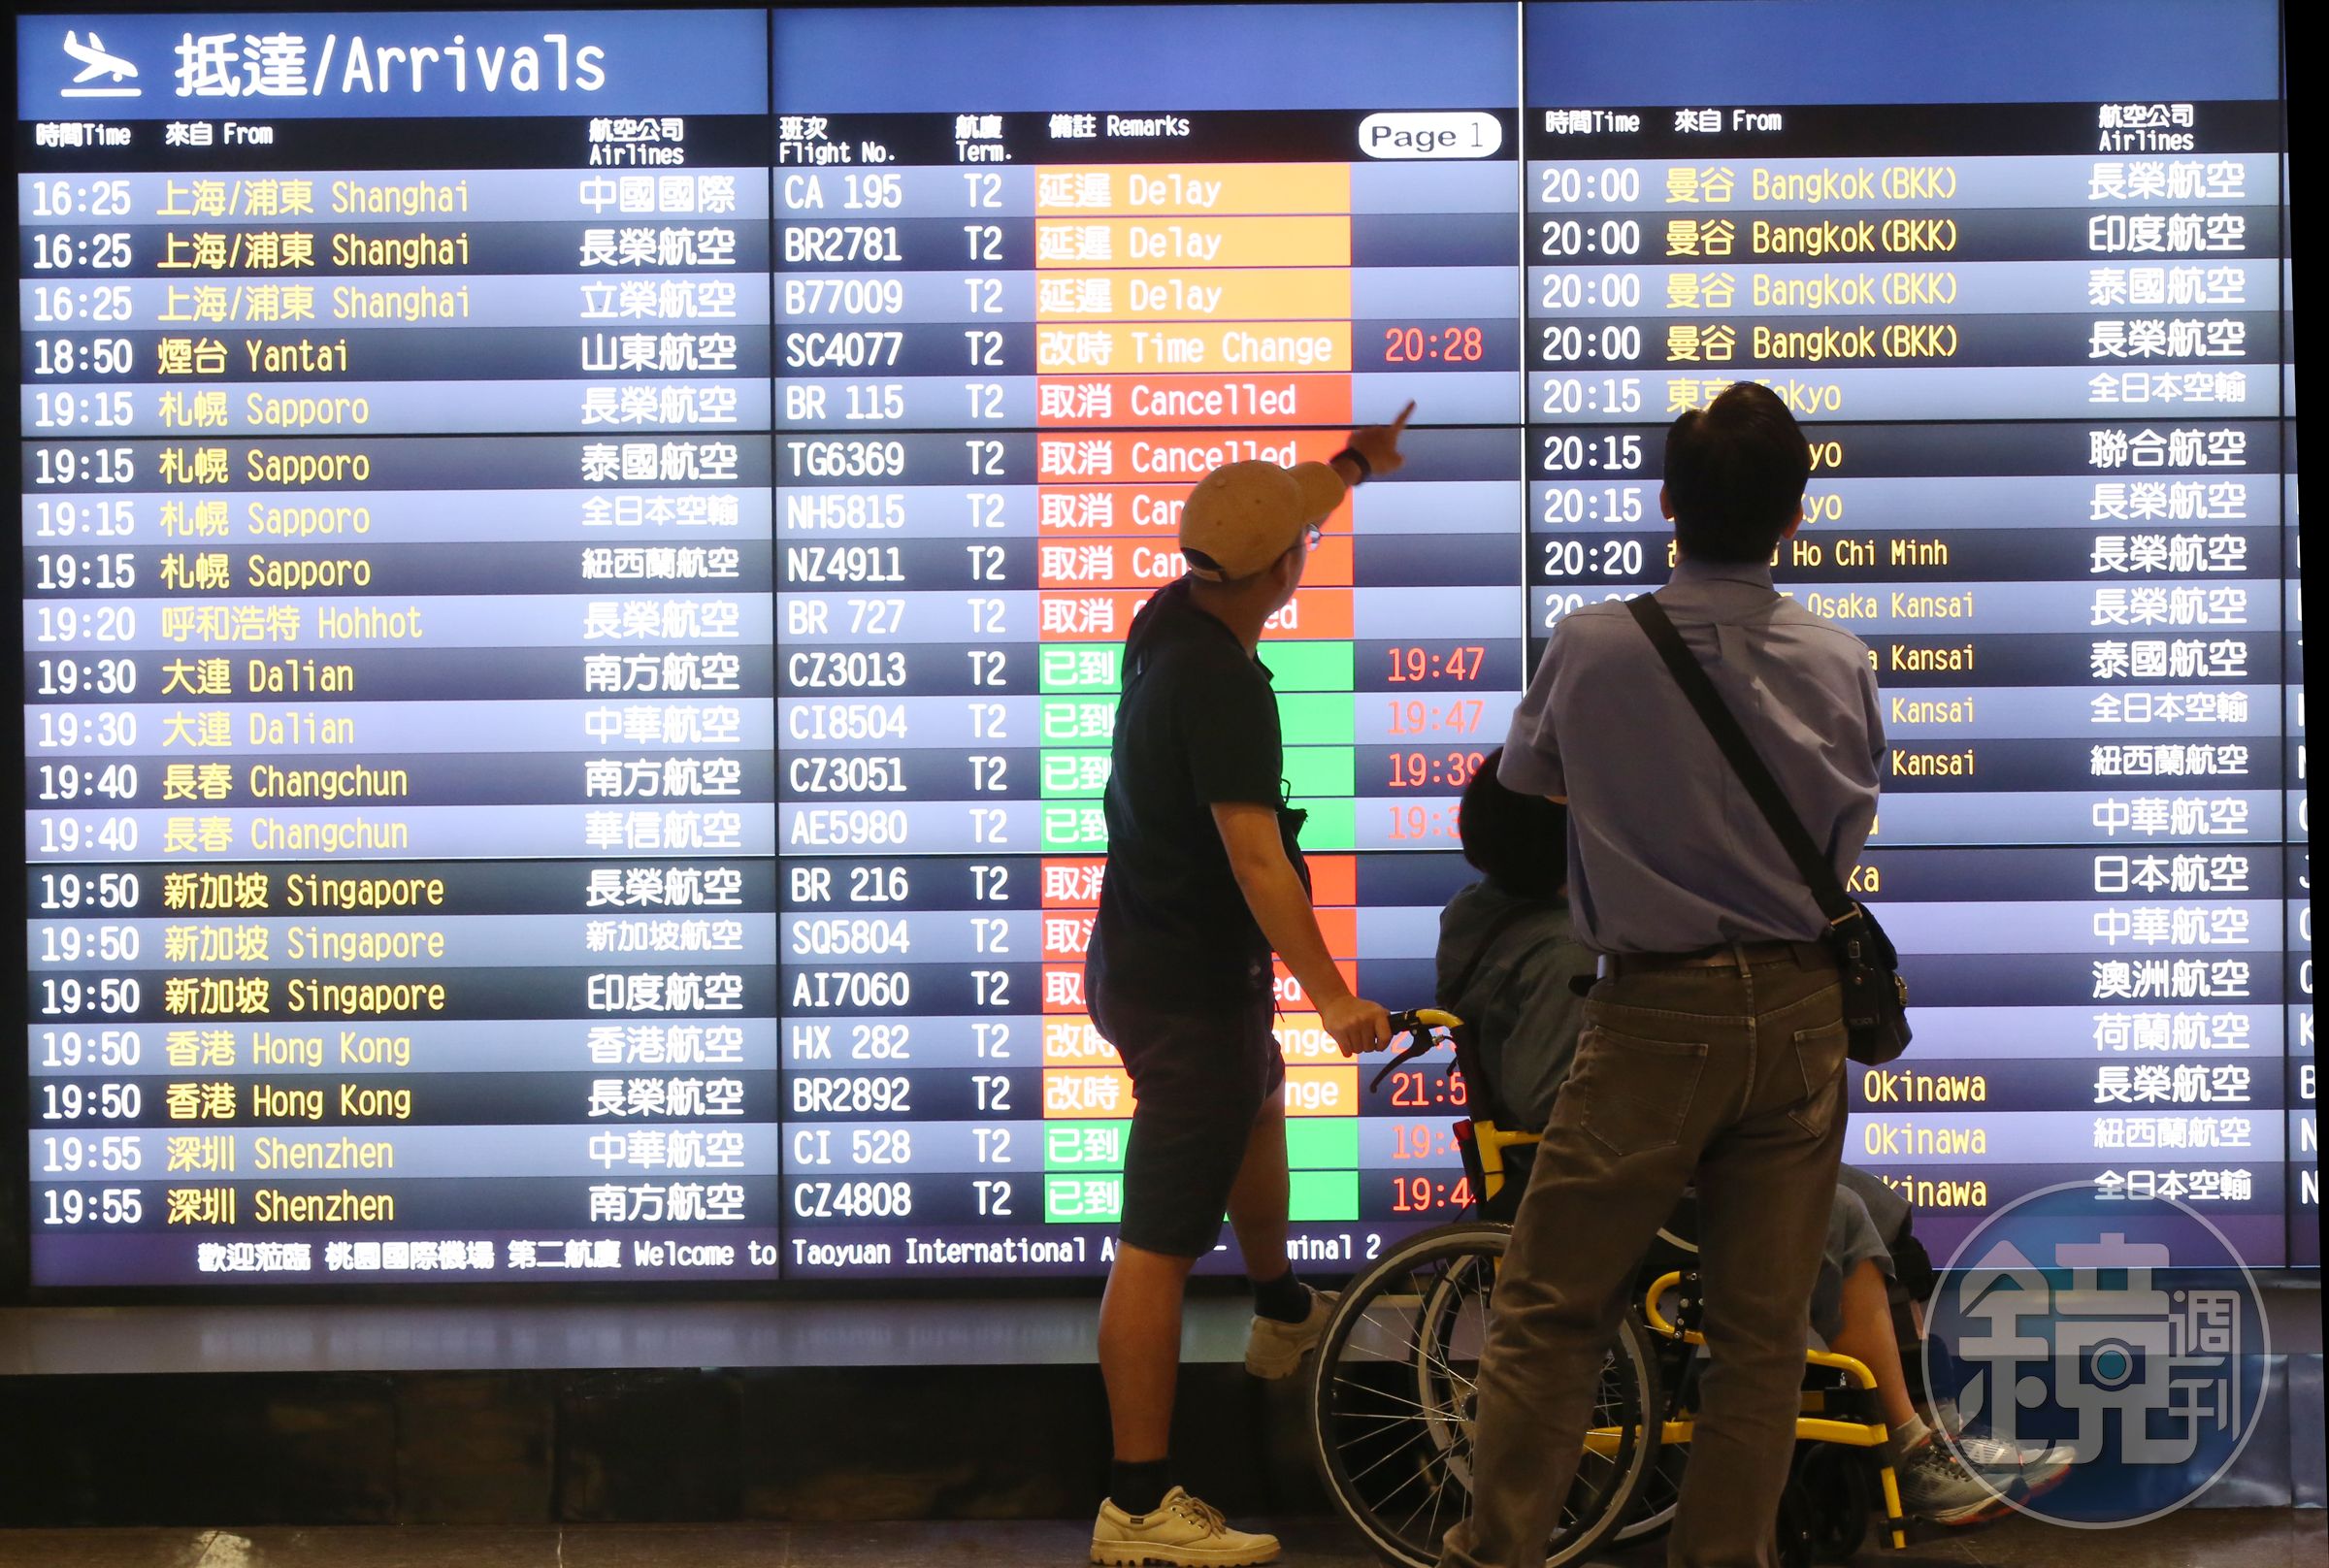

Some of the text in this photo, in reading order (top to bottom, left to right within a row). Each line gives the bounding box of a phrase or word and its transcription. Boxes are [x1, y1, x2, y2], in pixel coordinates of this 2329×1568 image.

[174, 31, 606, 98] 抵達/Arrivals
[35, 121, 132, 148] 時間Time
[165, 120, 274, 147] 來自 From
[588, 117, 684, 143] 航空公司
[1106, 114, 1191, 137] Remarks
[1545, 109, 1641, 135] 時間Time
[1674, 108, 1783, 134] 來自 From
[2098, 103, 2194, 129] 航空公司
[589, 143, 685, 166] Airlines
[779, 141, 896, 166] Flight No.
[955, 140, 1012, 163] Term.
[1371, 121, 1484, 152] Page 1
[2098, 129, 2195, 152] Airlines
[32, 180, 131, 216] 16:25
[156, 178, 469, 217] 上海/浦東 Shanghai
[579, 175, 736, 214] 中國國際
[784, 173, 902, 210] CA 195
[963, 172, 1002, 208] T2
[1038, 172, 1223, 209] 延遲 Delay
[1541, 167, 1640, 203] 20:00
[1664, 166, 1957, 204] 曼谷 Bangkok(BKK)
[2087, 159, 2246, 201] 長榮航空
[33, 232, 132, 269] 16:25
[155, 230, 470, 271] 上海/浦東 Shanghai
[578, 226, 737, 267] 長榮航空
[784, 226, 902, 262] BR2781
[964, 225, 1003, 261] T2
[1038, 225, 1223, 261] 延遲 Delay
[1542, 219, 1640, 256] 20:00
[1664, 218, 1958, 258] 曼谷 Bangkok(BKK)
[2088, 212, 2246, 253] 印度航空
[2087, 265, 2246, 307] 泰國航空
[34, 338, 133, 375] 18:50
[156, 337, 349, 376] 煙台 Yantai
[581, 332, 738, 373] 山東航空
[786, 331, 903, 368] SC4077
[964, 330, 1004, 366] T2
[1039, 330, 1333, 367] 改時 Time Change
[1384, 326, 1484, 363] 20:28
[580, 384, 738, 425] 長榮航空
[786, 383, 904, 420] BR 115
[965, 382, 1004, 418] T2
[1039, 382, 1296, 419] 取消 Cancelled
[1543, 377, 1641, 413] 20:15
[2087, 370, 2247, 404] 全日本空輸
[35, 390, 134, 427] 19:15
[158, 390, 371, 429] 札幌 Sapporo
[1543, 435, 1642, 471] 20:15
[2088, 428, 2247, 469] 聯合航空
[37, 553, 136, 589] 19:15
[159, 552, 373, 591] 札幌 Sapporo
[581, 545, 739, 580] 紐西蘭航空
[787, 546, 905, 582] NZ4911
[966, 545, 1006, 581] T2
[1040, 544, 1114, 581] 取消
[1544, 539, 1643, 575] 20:20
[1791, 539, 1951, 568] Ho Chi Minh
[2089, 533, 2247, 573] 長榮航空
[37, 605, 136, 642] 19:20
[161, 604, 424, 643] 呼和浩特 Hohhot
[582, 599, 739, 639] 長榮航空
[788, 599, 906, 635] BR 727
[967, 598, 1006, 634] T2
[1041, 597, 1114, 634] 取消
[1890, 591, 1974, 619] Kansai
[2090, 585, 2247, 626] 長榮航空
[582, 651, 740, 693] 南方航空
[789, 651, 906, 688] CZ3013
[967, 650, 1007, 686] T2
[1043, 650, 1115, 686] 已到
[1387, 645, 1486, 683] 19:47
[1890, 643, 1975, 672] Kansai
[2089, 638, 2248, 679] 泰國航空
[38, 658, 137, 695] 19:30
[161, 657, 355, 696] 大連 Dalian
[584, 756, 741, 798] 南方航空
[790, 756, 907, 793] CZ3051
[968, 755, 1008, 791] T2
[1890, 748, 1976, 777] Kansai
[2089, 743, 2249, 776] 紐西蘭航空
[39, 764, 138, 800] 19:40
[162, 762, 409, 801] 長春 Changchun
[2094, 853, 2249, 894] 日本航空
[41, 925, 140, 962] 19:50
[164, 924, 445, 964] 新加坡 Singapore
[585, 919, 743, 952] 新加坡航空
[792, 919, 910, 955] SQ5804
[969, 918, 1009, 953] T2
[2091, 959, 2250, 999] 澳洲航空
[2092, 1011, 2250, 1052] 荷蘭航空
[42, 1083, 142, 1120] 19:50
[165, 1082, 413, 1122] 香港 Hong Kong
[587, 1076, 744, 1117] 長榮航空
[793, 1076, 911, 1113] BR2892
[971, 1075, 1011, 1111] T2
[1046, 1074, 1120, 1111] 改時
[1862, 1069, 1988, 1103] Okinawa
[2093, 1063, 2251, 1104] 長榮航空
[1864, 1122, 1987, 1156] Okinawa
[2092, 1116, 2251, 1149] 紐西蘭航空
[588, 1182, 745, 1223] 南方航空
[794, 1181, 912, 1218] CZ4808
[972, 1180, 1012, 1216] T2
[1049, 1179, 1120, 1216] 已到
[2093, 1168, 2252, 1201] 全日本空輸
[43, 1188, 143, 1225] 19:55
[166, 1187, 396, 1225] 深圳 Shenzhen
[324, 1240, 496, 1271] 桃園國際機場
[634, 1240, 735, 1267] Welcome
[747, 1240, 777, 1266] to
[791, 1238, 891, 1267] Taoyuan
[905, 1236, 1085, 1264] International
[1286, 1233, 1352, 1260] minal
[1365, 1233, 1381, 1260] 2
